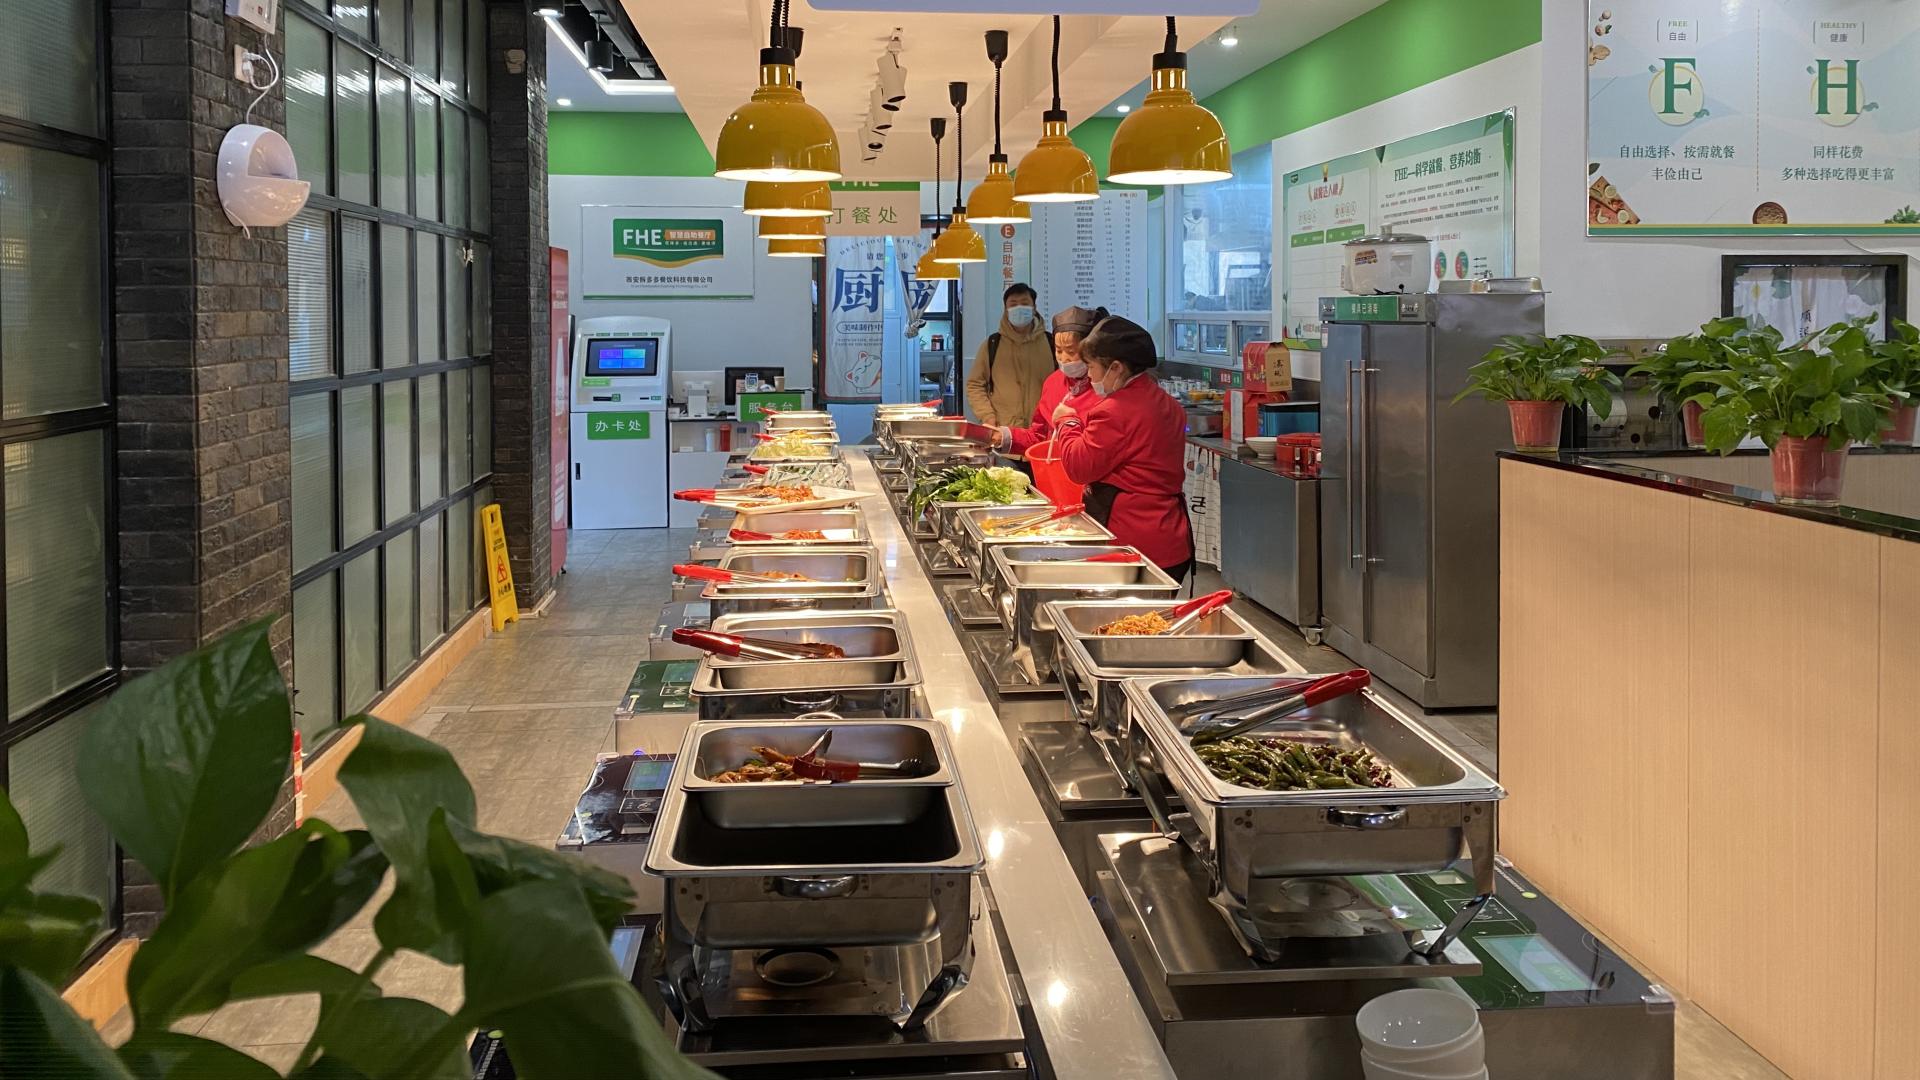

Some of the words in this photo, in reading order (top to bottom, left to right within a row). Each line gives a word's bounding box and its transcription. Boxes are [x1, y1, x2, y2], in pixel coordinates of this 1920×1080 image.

[1668, 32, 1687, 41] 自由
[1829, 33, 1848, 43] 健康
[1657, 57, 1696, 114] F
[1815, 59, 1860, 115] H
[1619, 145, 1735, 159] 自由选择、按需就餐
[1813, 145, 1863, 159] 同样花费
[1652, 168, 1703, 181] 丰俭由己
[1782, 168, 1895, 181] 多种选择吃得更丰富
[623, 229, 662, 245] FHE
[840, 239, 883, 256] DELICIOU
[896, 239, 927, 250] KITCHE
[595, 420, 641, 432] 办卡处
